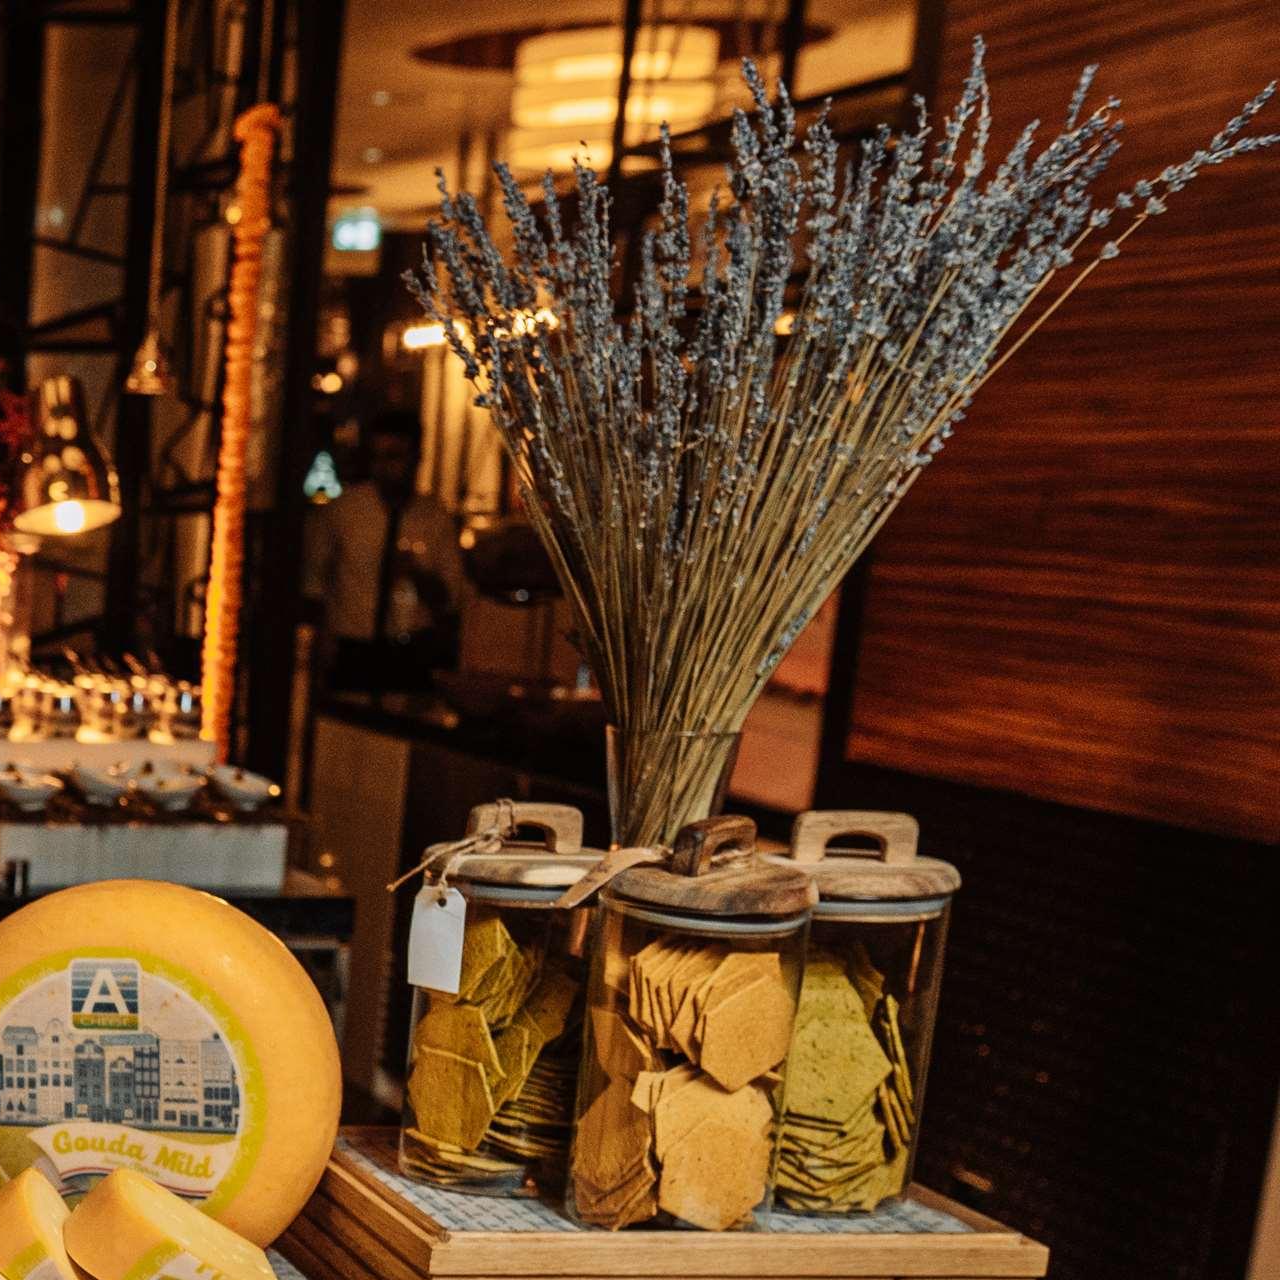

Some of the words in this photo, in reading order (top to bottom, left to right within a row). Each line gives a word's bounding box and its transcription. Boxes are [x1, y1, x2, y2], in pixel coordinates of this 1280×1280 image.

[80, 968, 132, 1014] A
[52, 1130, 146, 1160] Gouda
[154, 1146, 215, 1179] Mild
